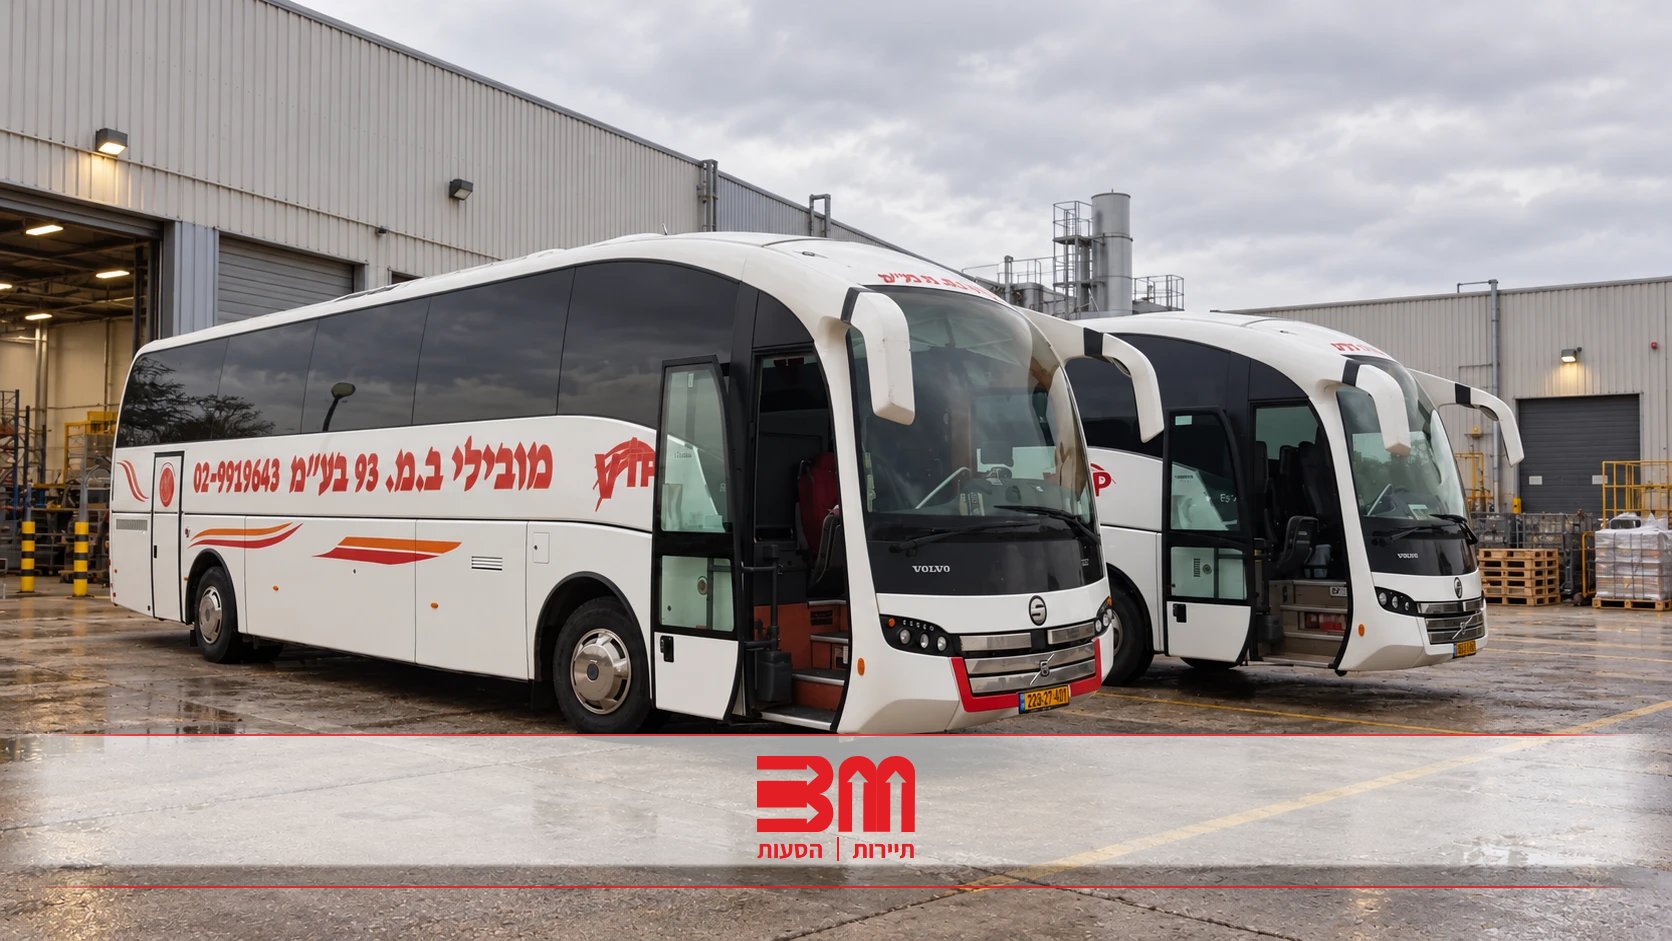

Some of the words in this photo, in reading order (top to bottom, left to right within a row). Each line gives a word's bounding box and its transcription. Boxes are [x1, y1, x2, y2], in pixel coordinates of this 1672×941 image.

[193, 458, 280, 493] 02-9919643
[354, 452, 379, 493] 93
[451, 436, 554, 492] מובילי
[911, 565, 950, 573] VOLVO
